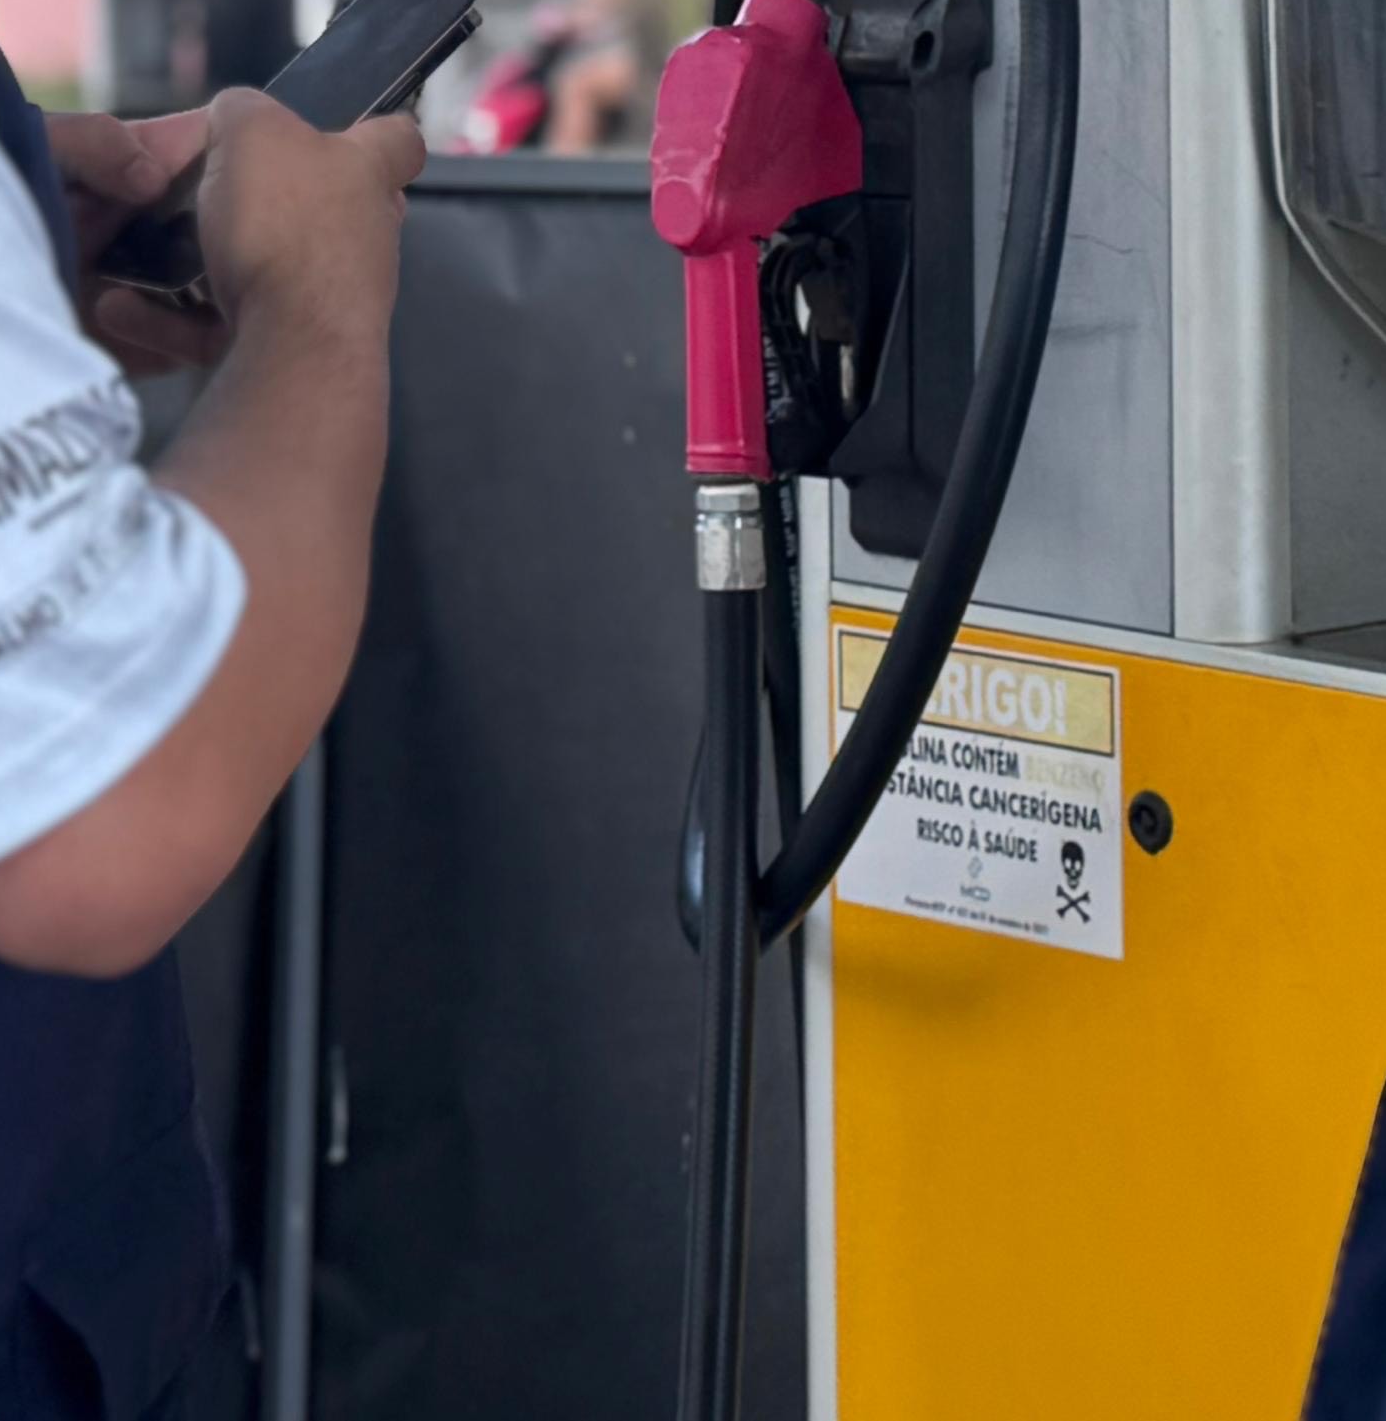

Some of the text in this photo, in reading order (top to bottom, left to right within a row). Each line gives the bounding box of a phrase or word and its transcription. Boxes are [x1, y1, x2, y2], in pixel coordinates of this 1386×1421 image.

[951, 739, 1021, 780] CONTÉM
[969, 785, 1104, 834] CANCERÍGENA
[916, 817, 1039, 863] RISCO À SAÚDE
